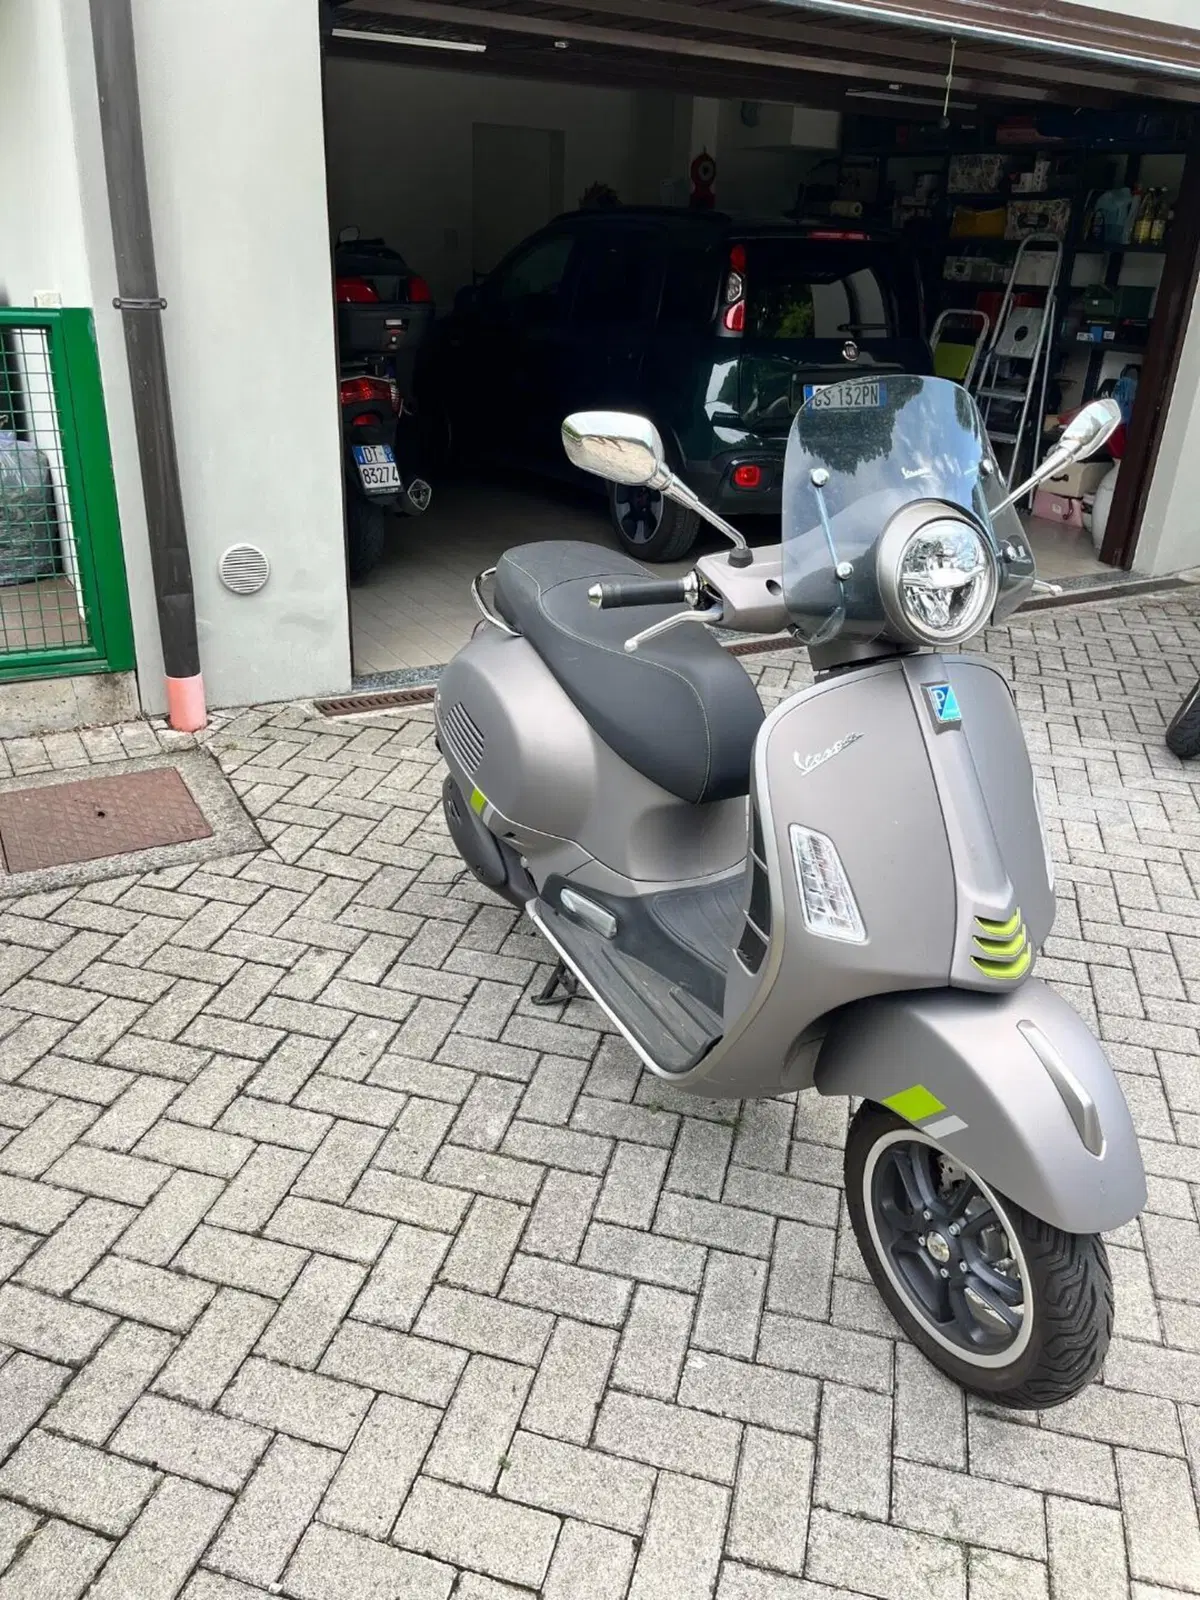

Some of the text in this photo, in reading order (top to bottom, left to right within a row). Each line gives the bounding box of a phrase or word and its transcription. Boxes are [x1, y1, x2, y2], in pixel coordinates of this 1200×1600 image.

[814, 385, 878, 407] GS 132PN
[363, 446, 378, 463] DT
[362, 467, 398, 485] 83274
[792, 731, 865, 777] Vespa
